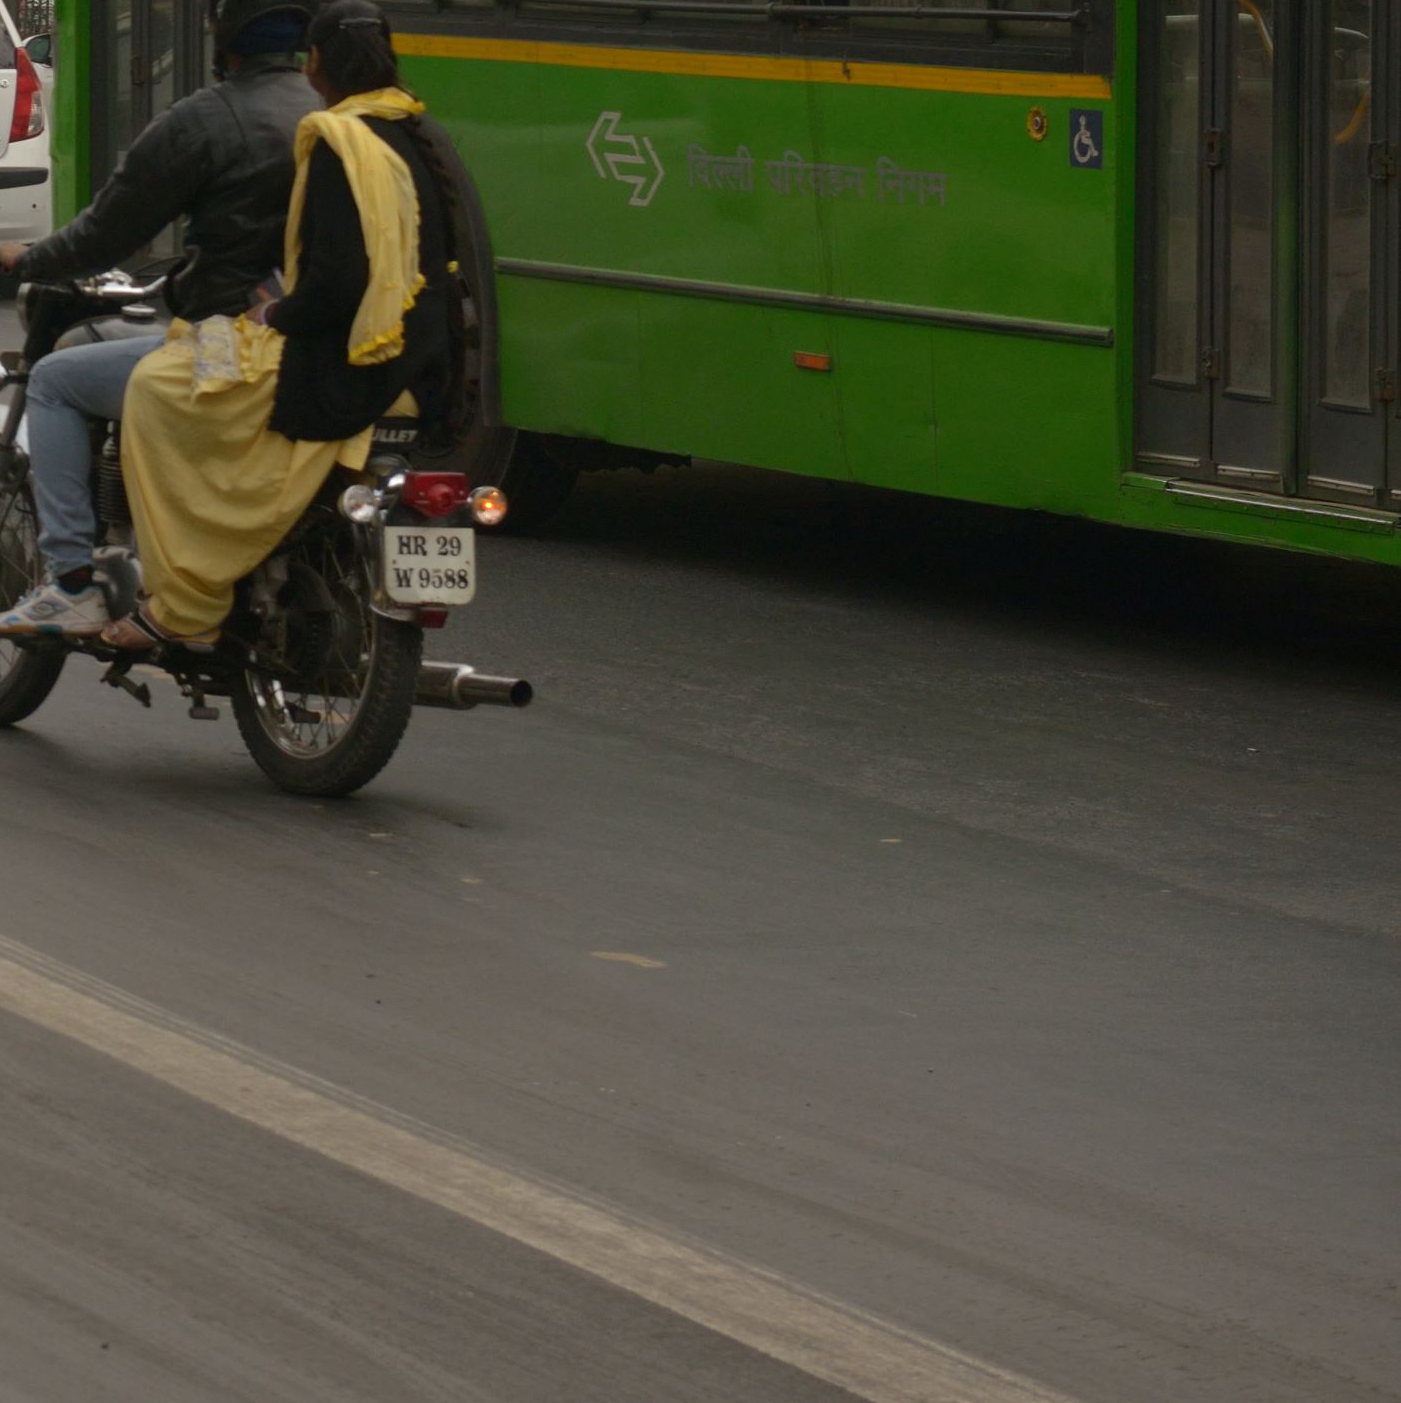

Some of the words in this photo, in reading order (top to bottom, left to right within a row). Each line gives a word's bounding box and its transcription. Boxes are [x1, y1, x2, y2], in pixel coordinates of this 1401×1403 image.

[686, 143, 755, 191] दिल्ली
[877, 155, 946, 206] निगम
[396, 534, 428, 557] HR
[436, 535, 462, 557] 29
[393, 567, 414, 588] W
[418, 567, 469, 589] 9588
